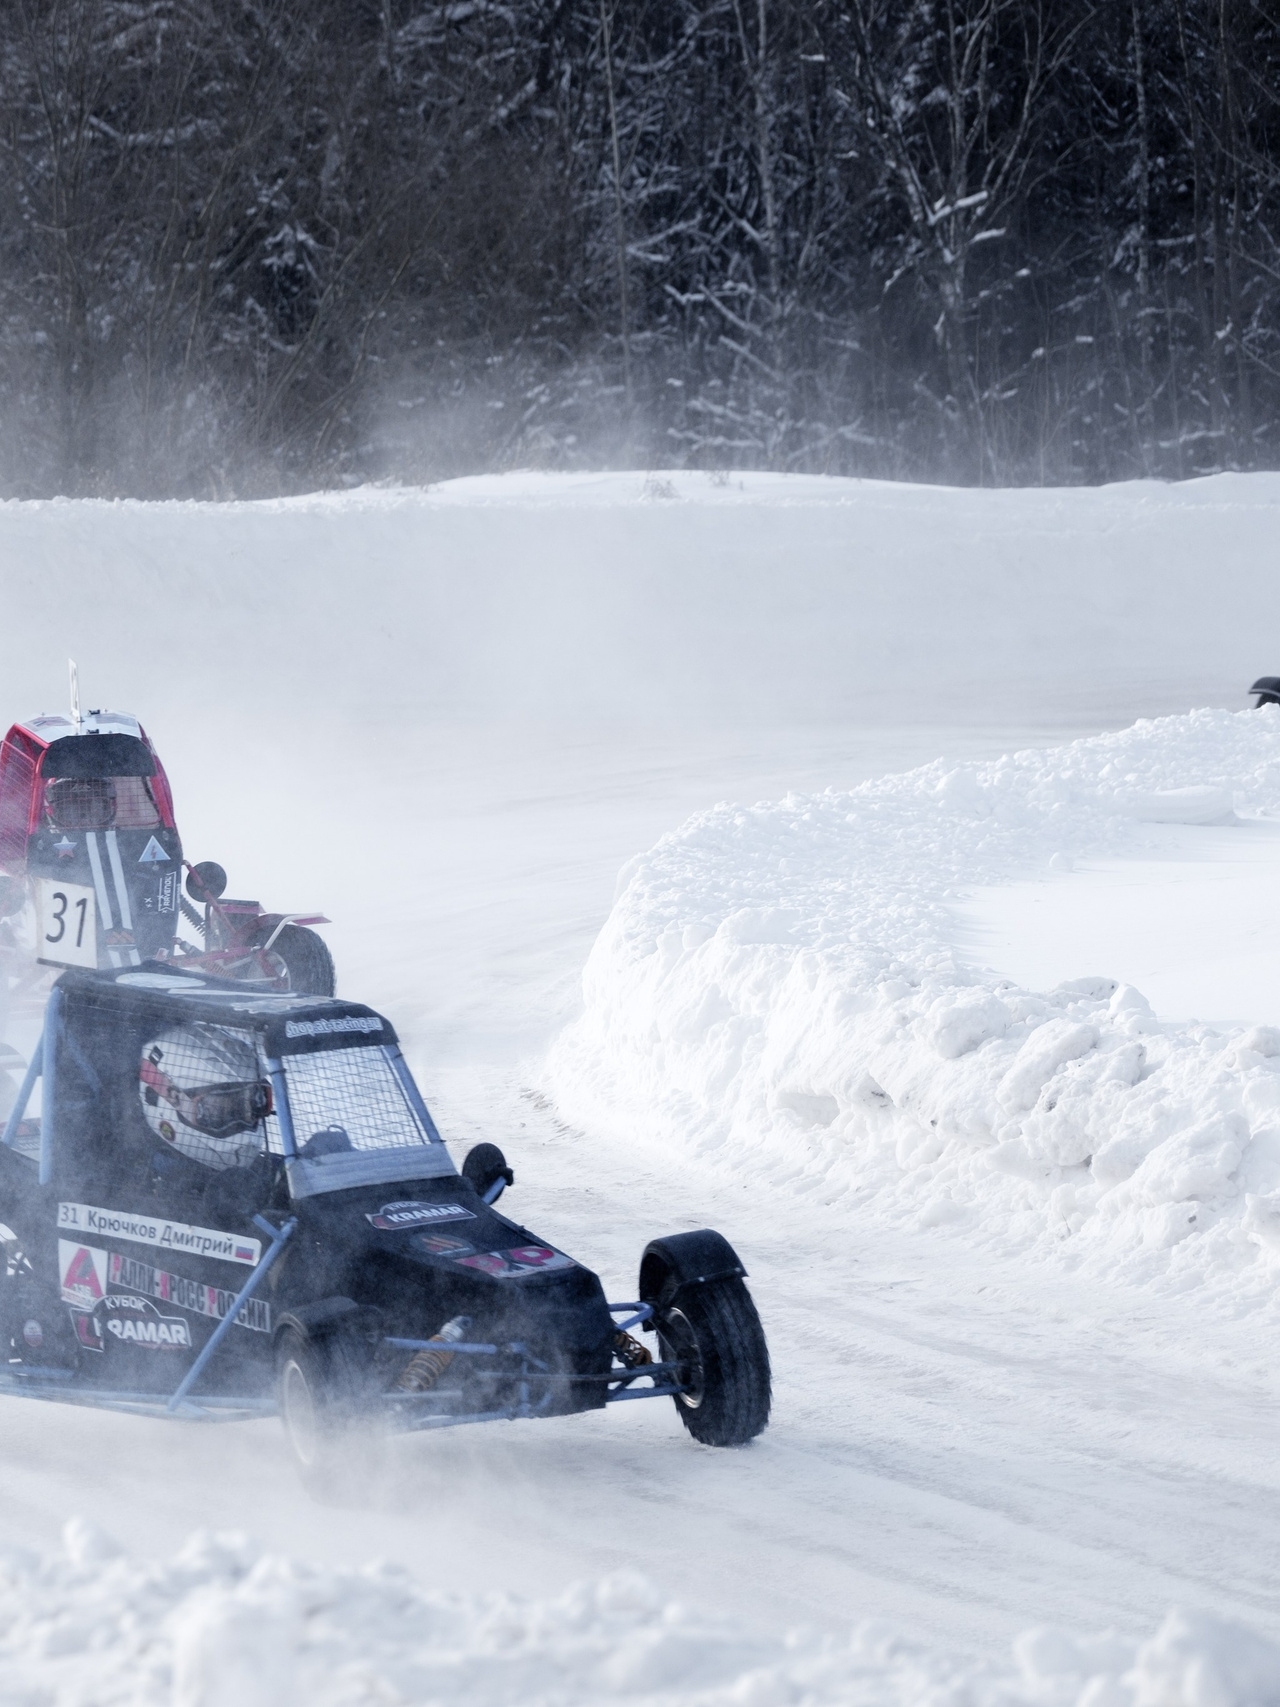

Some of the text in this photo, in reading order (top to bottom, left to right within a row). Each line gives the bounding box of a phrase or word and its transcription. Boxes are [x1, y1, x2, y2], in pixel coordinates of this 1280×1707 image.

[46, 892, 87, 947] 31
[61, 1205, 233, 1254] 31 Крючков Дмитрий
[387, 1205, 467, 1223] KRAMAR
[105, 1297, 146, 1313] КУБОК
